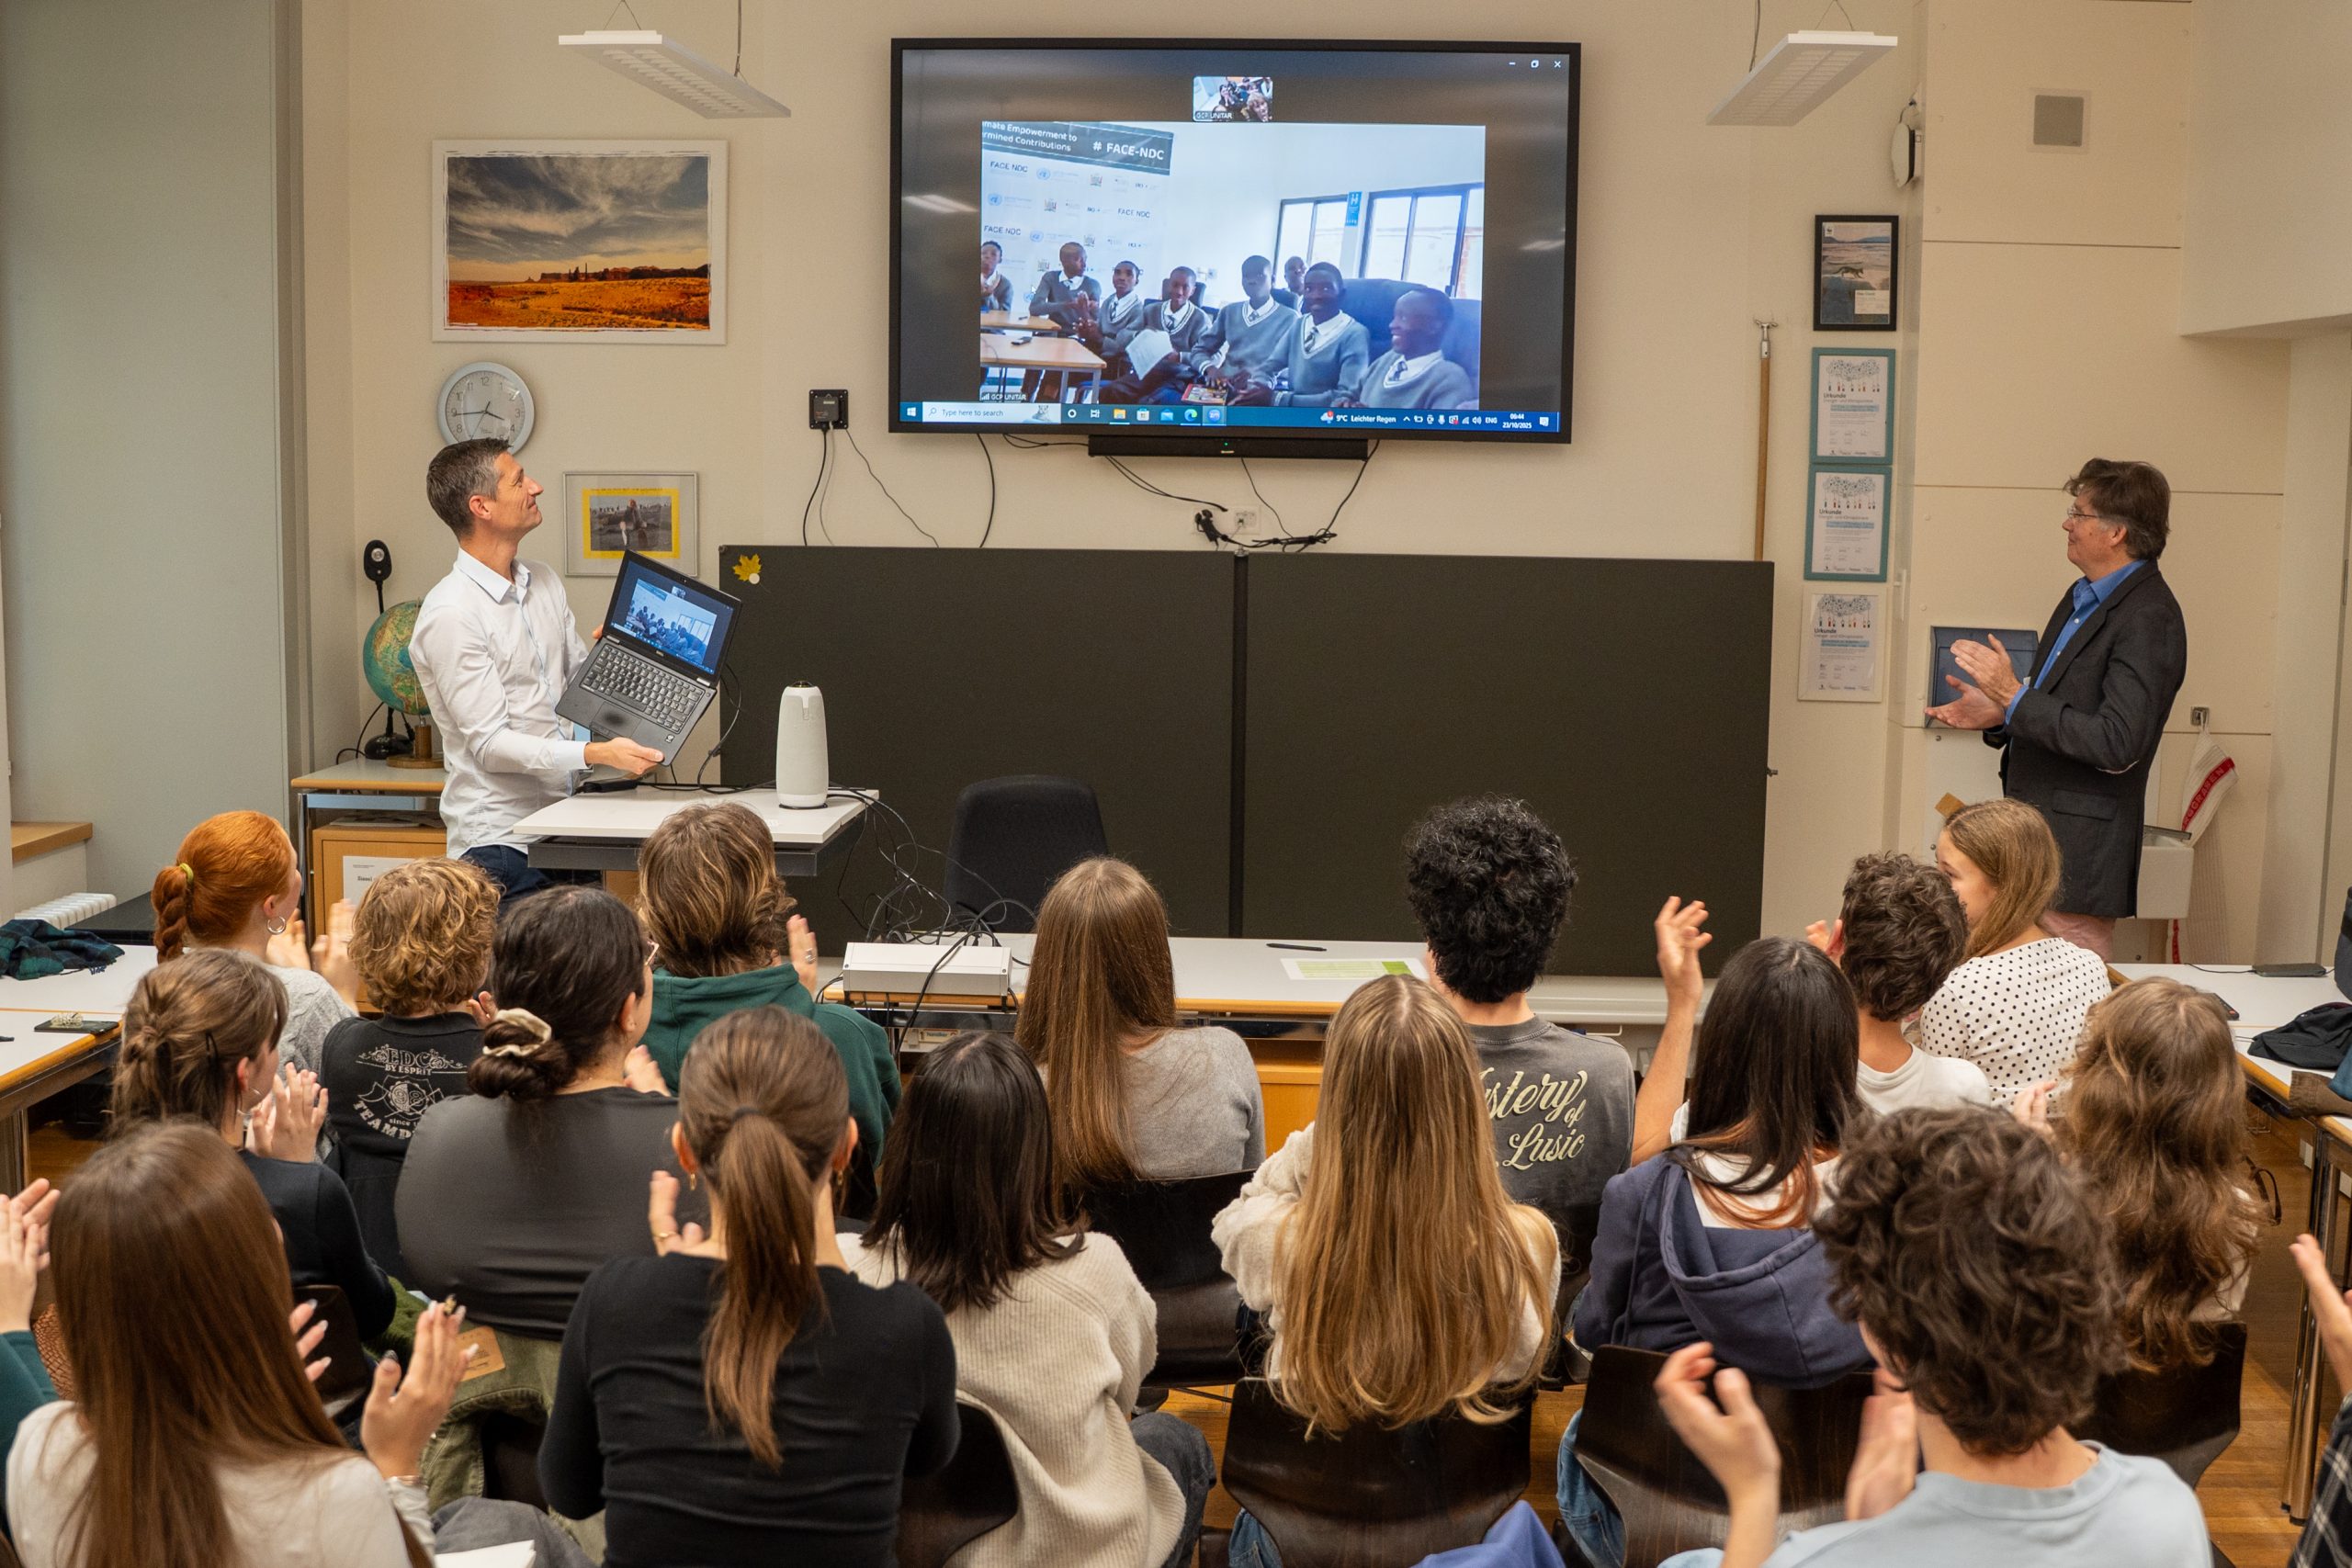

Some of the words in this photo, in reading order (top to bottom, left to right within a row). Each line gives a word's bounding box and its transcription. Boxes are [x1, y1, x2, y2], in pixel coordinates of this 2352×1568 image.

[1007, 123, 1068, 140] Empowerment
[1069, 134, 1078, 142] to
[1015, 136, 1072, 152] Contributions
[1093, 141, 1102, 152] #
[1106, 142, 1165, 160] FACE-NDC
[990, 162, 1010, 170] FACE
[1117, 208, 1134, 217] FACE
[983, 225, 1003, 233] FACE
[468, 382, 473, 390] 11
[481, 377, 490, 386] 12
[500, 382, 503, 390] 1
[451, 408, 458, 417] 9
[514, 408, 520, 418] 3
[942, 409, 957, 418] Type
[1376, 415, 1396, 424] Regen
[457, 423, 463, 434] 8
[387, 1047, 432, 1067] EDC
[384, 1063, 397, 1073] BY
[398, 1066, 433, 1077] ESPRIT
[1479, 1066, 1588, 1122] stery
[1564, 1099, 1587, 1128] of
[390, 1118, 412, 1127] since
[1503, 1122, 1586, 1170] Lusic
